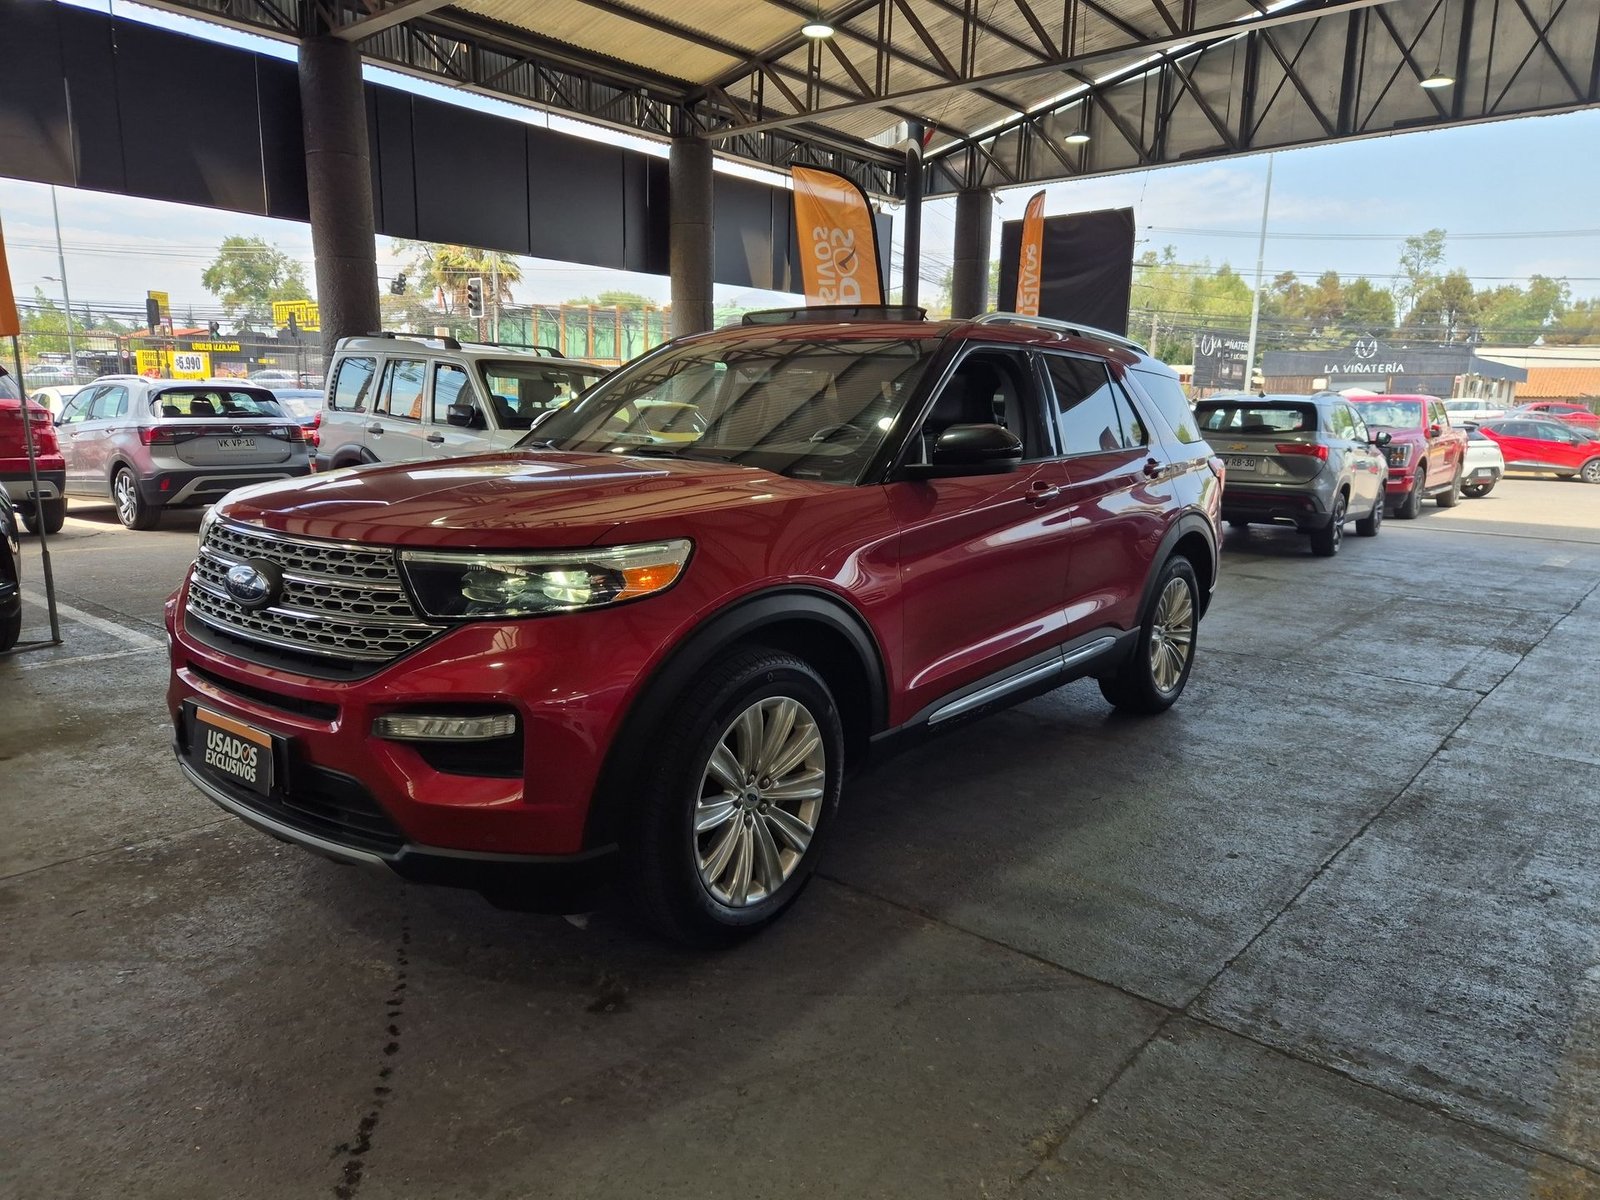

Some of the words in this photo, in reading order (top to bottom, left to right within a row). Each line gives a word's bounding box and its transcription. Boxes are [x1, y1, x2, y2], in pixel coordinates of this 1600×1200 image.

[176, 356, 201, 370] $5.990
[1324, 364, 1339, 374] LA
[1343, 362, 1405, 374] VIÑATERÍA
[206, 729, 258, 767] USADOS
[205, 748, 256, 783] EXCLUSIVOS
